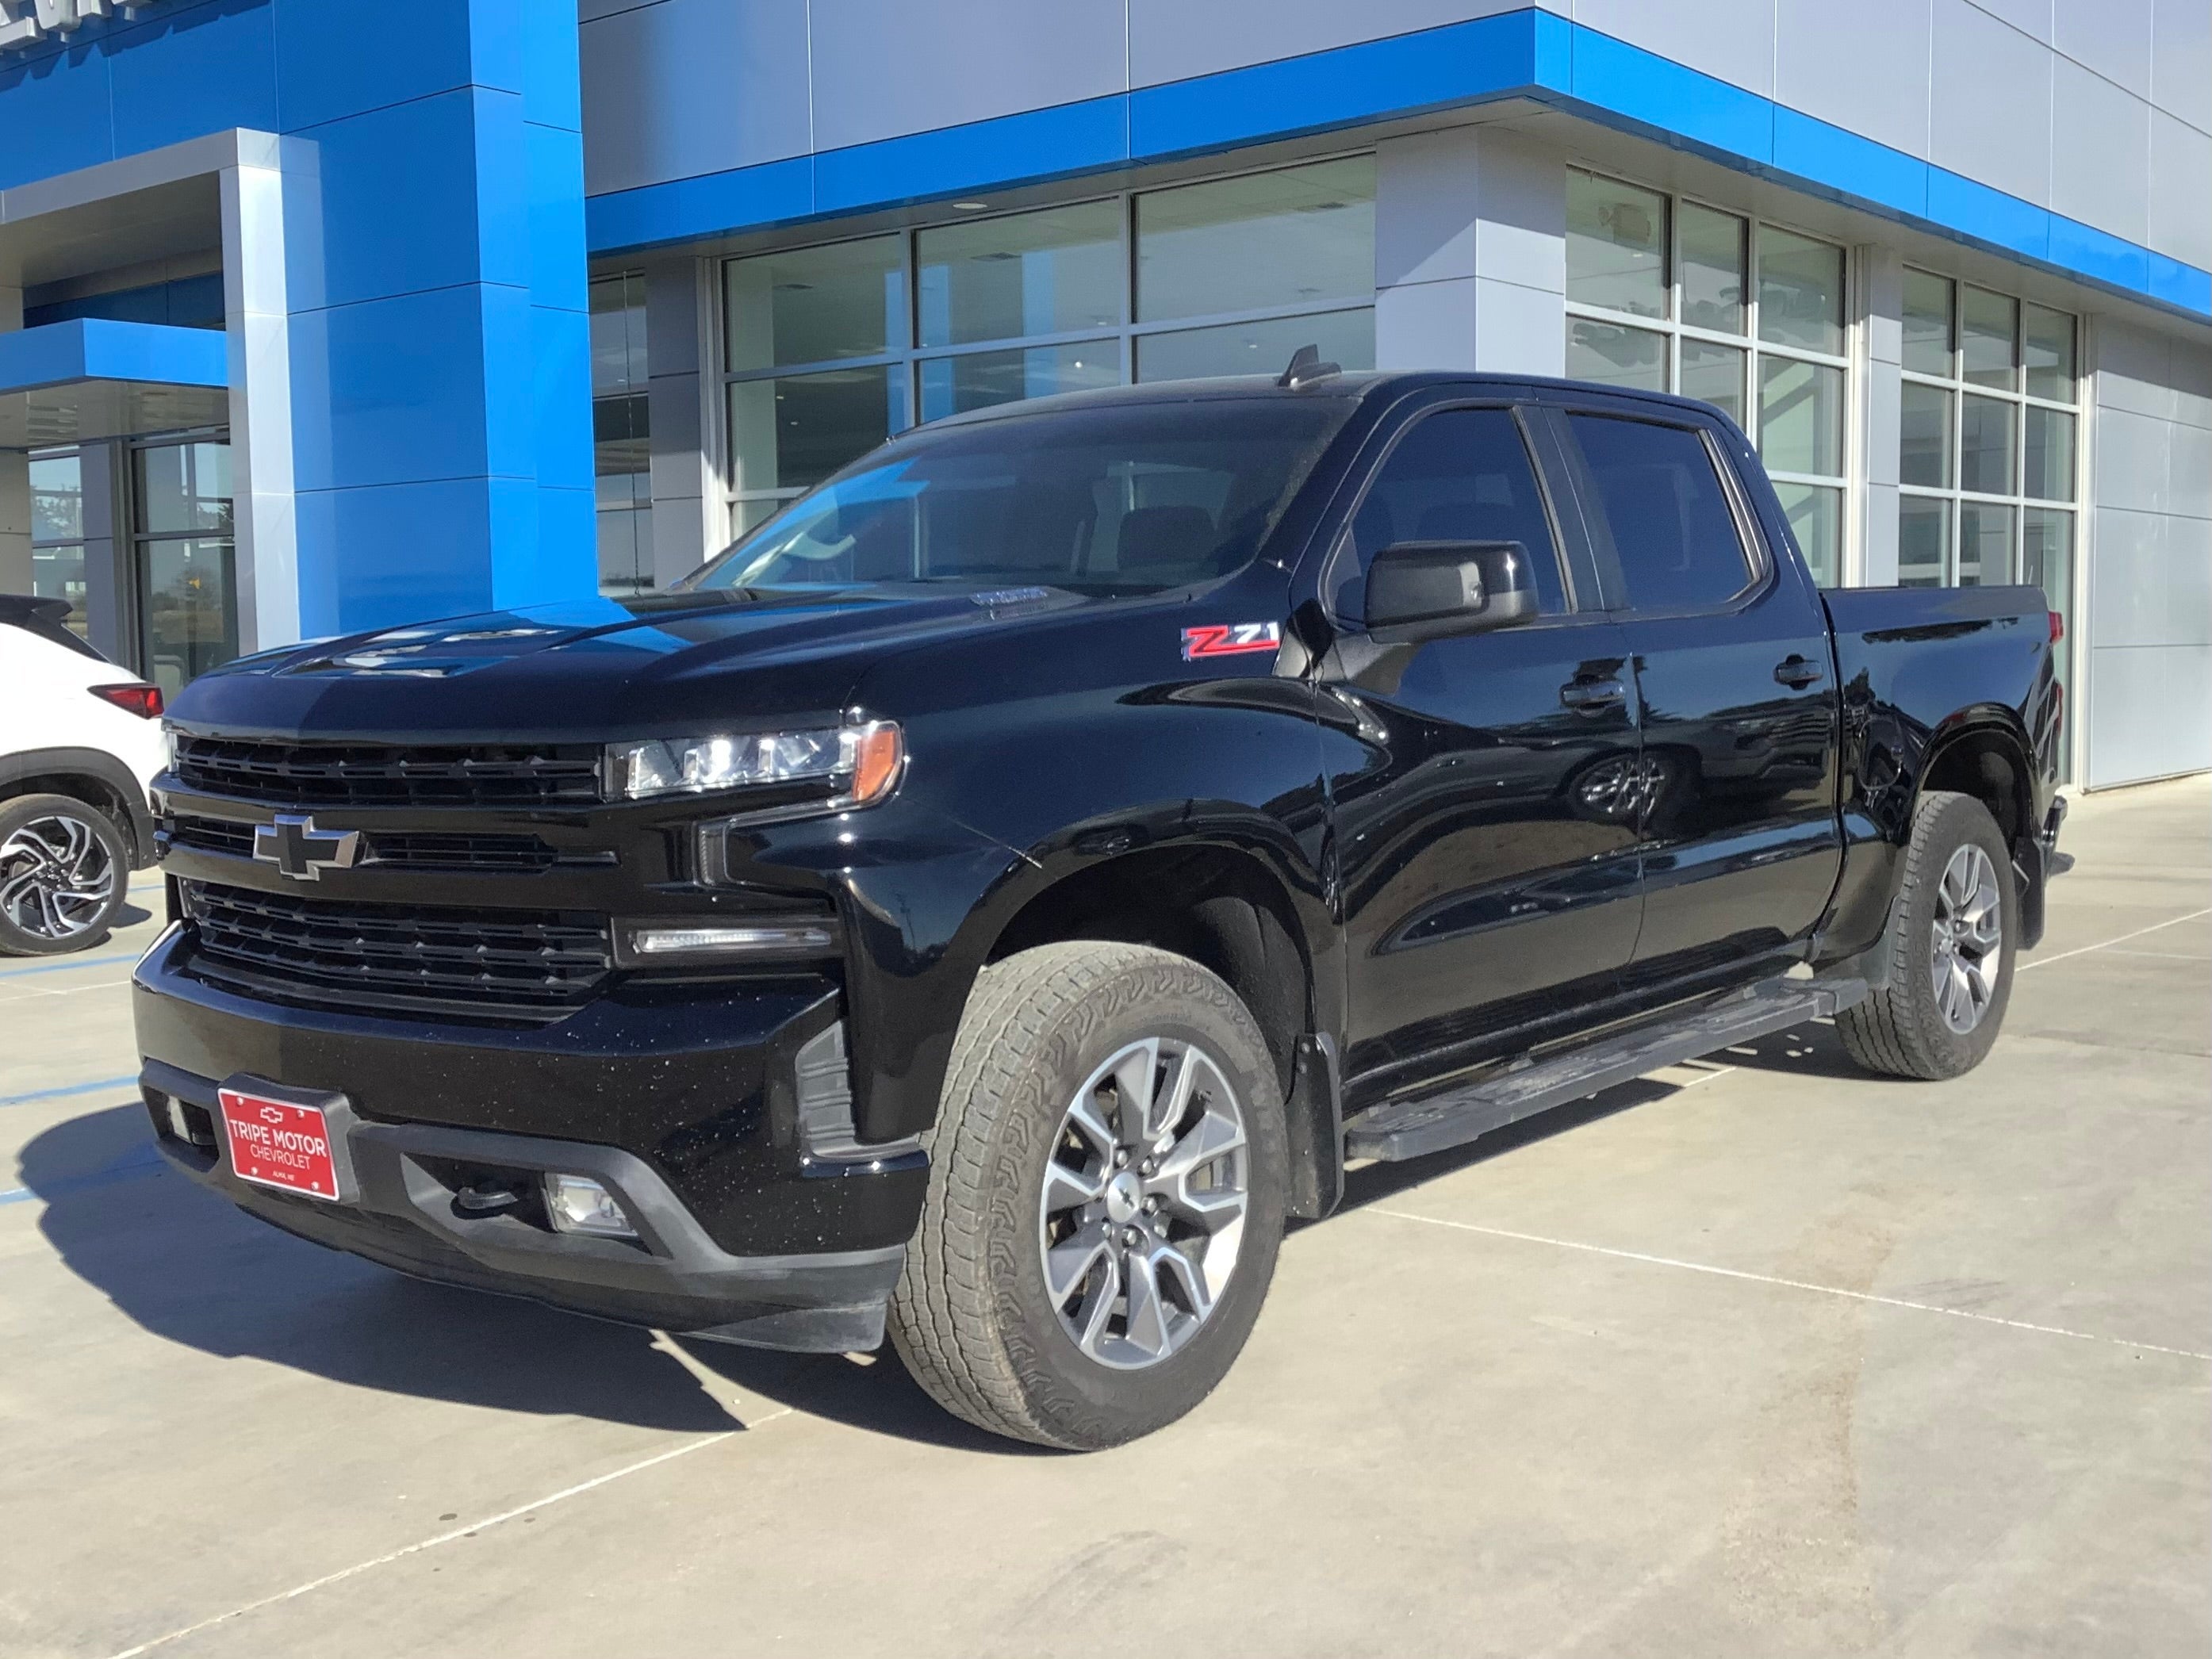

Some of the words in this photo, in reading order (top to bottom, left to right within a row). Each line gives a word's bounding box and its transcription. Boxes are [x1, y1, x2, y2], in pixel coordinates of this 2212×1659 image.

[1185, 622, 1279, 657] Z71
[230, 1119, 270, 1144] TRIPE
[273, 1129, 327, 1158] MOTOR
[250, 1144, 311, 1170] CHEVROLET
